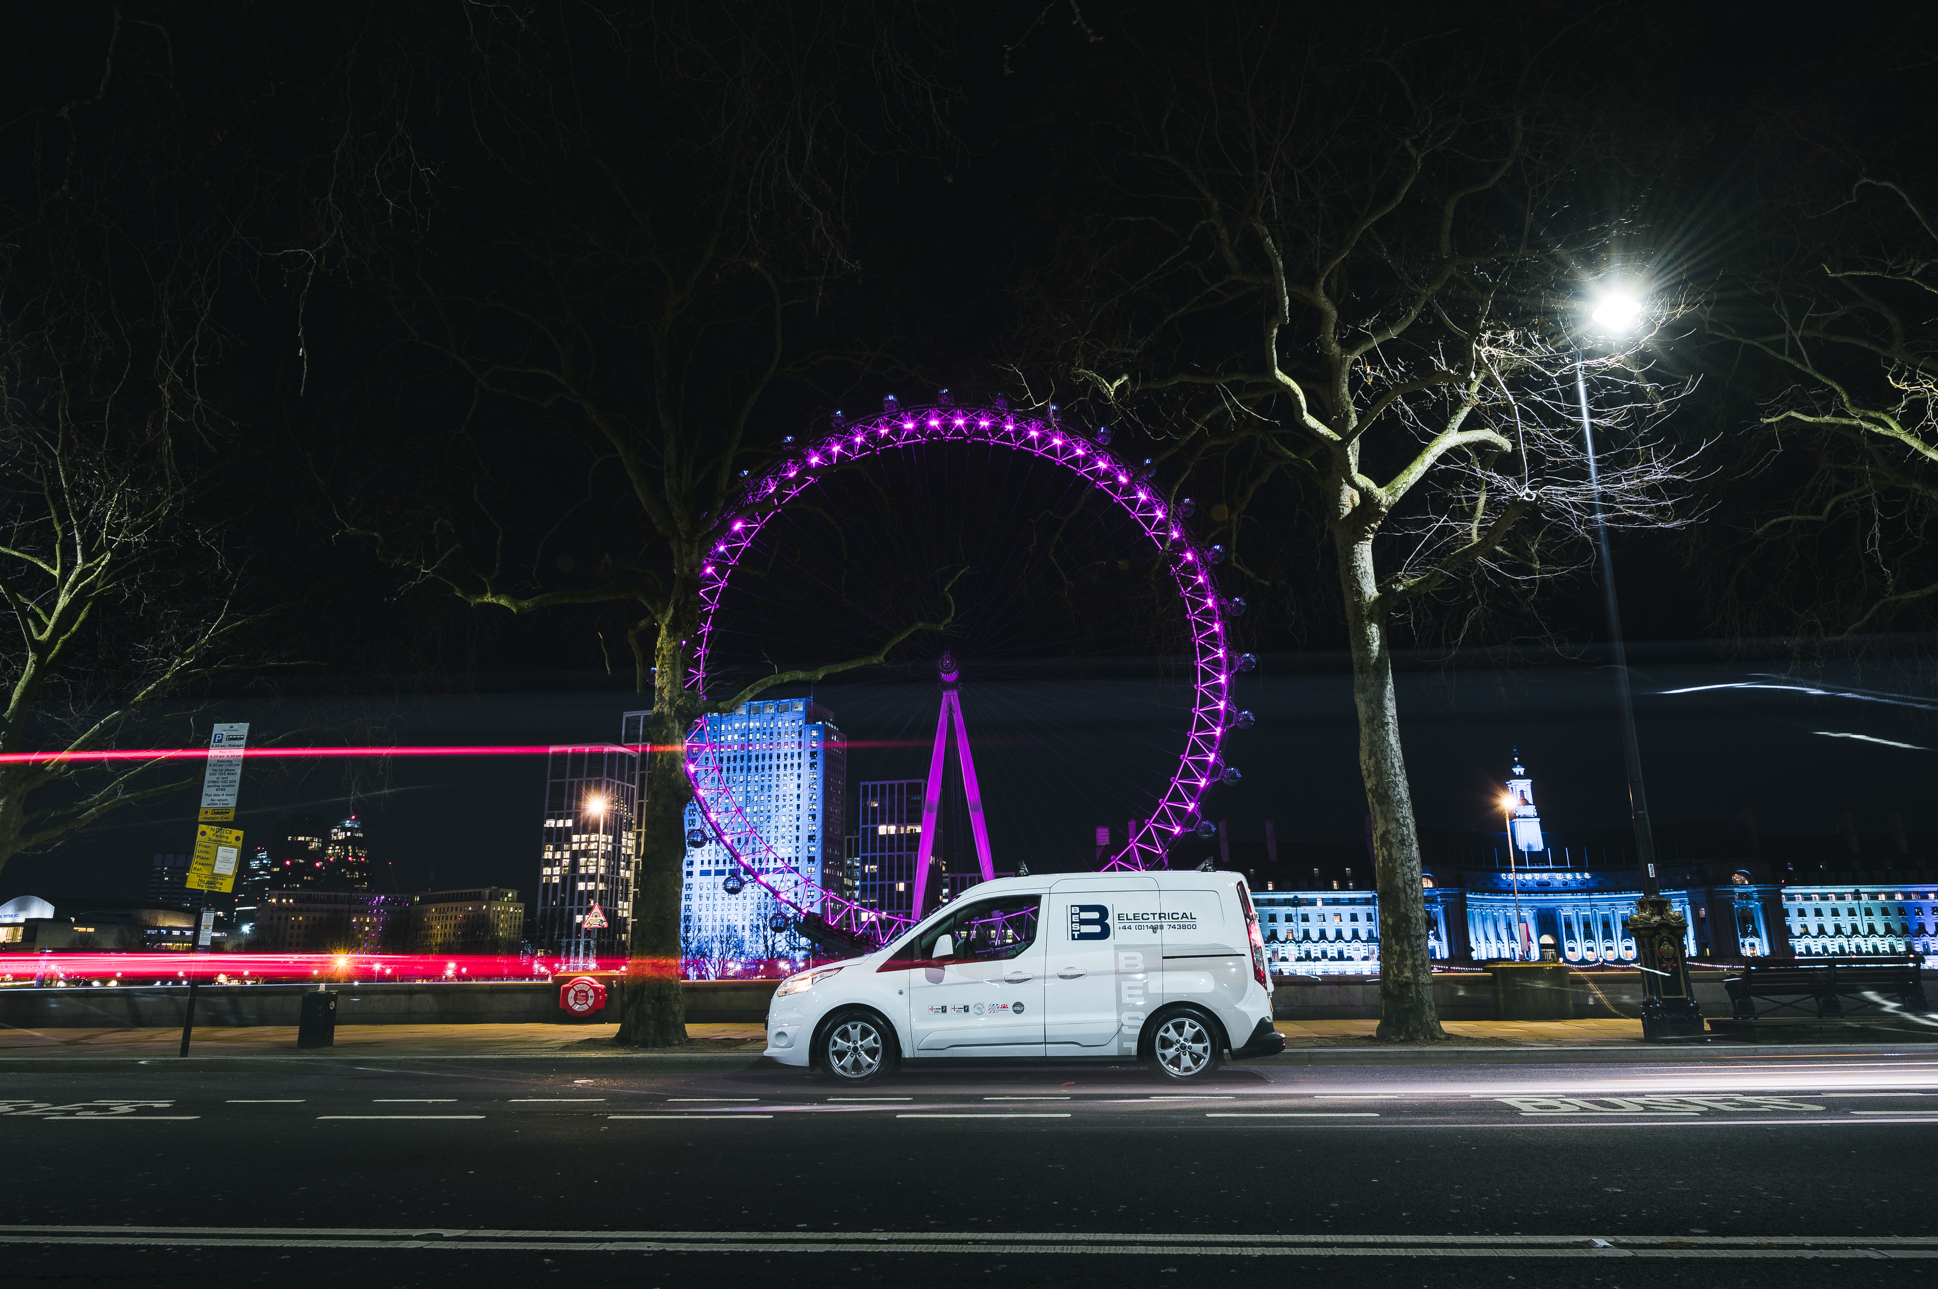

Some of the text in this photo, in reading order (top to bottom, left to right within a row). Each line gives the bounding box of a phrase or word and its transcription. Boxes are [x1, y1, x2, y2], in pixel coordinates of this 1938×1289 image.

[210, 826, 232, 835] NOTICE
[1117, 912, 1197, 921] ELECTRICAL
[1071, 906, 1080, 939] BEST
[1497, 1098, 1826, 1111] BUSES
